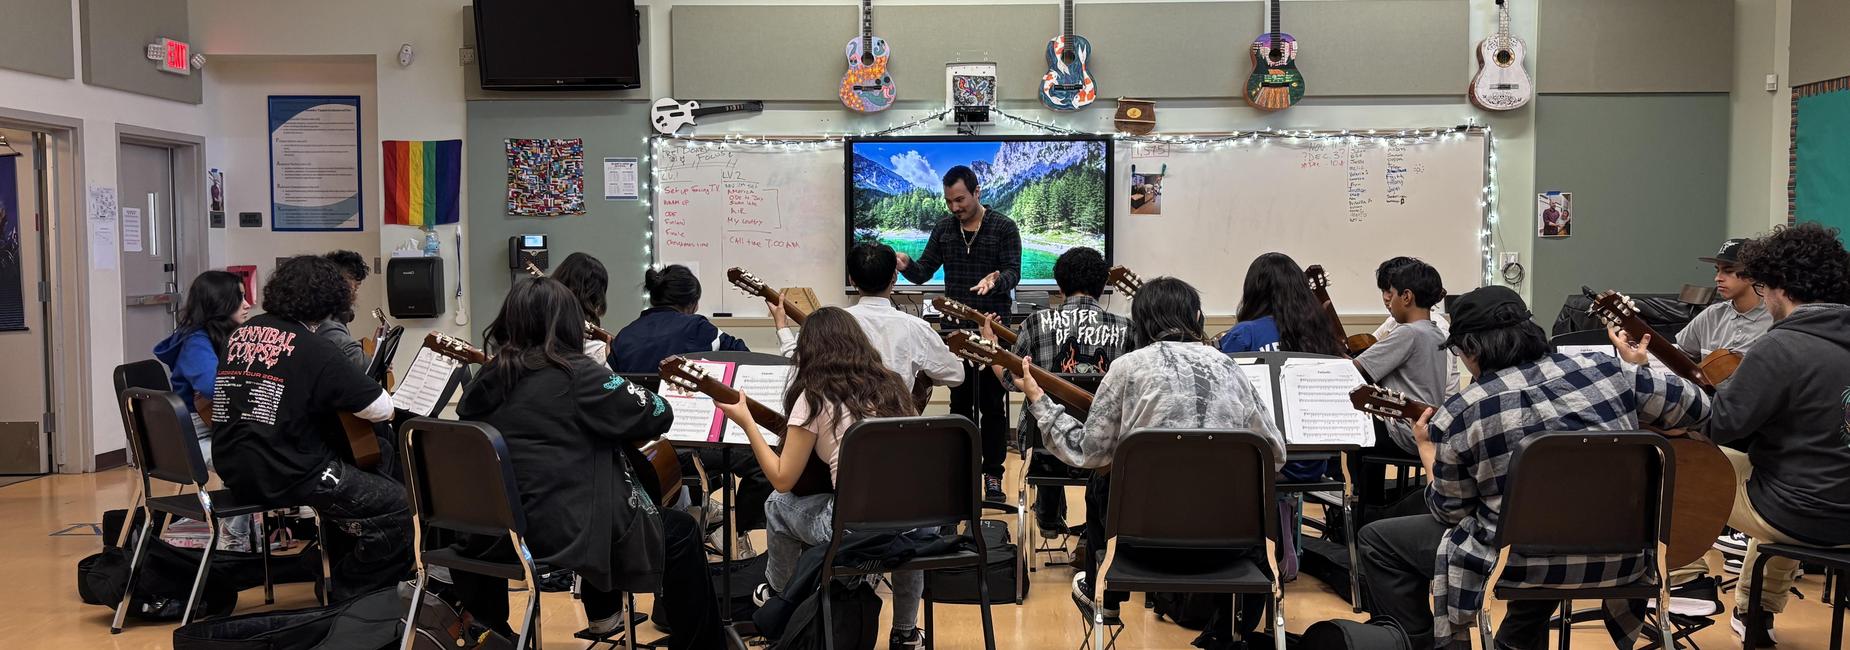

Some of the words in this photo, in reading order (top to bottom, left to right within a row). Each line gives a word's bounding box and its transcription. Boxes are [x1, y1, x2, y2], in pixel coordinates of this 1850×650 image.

[167, 40, 187, 69] EXIT
[1040, 308, 1098, 333] MASTER
[227, 325, 297, 357] CANNIBAL
[1055, 327, 1070, 346] OF
[1076, 323, 1128, 350] FRIGHT
[226, 340, 282, 371] CORPSE
